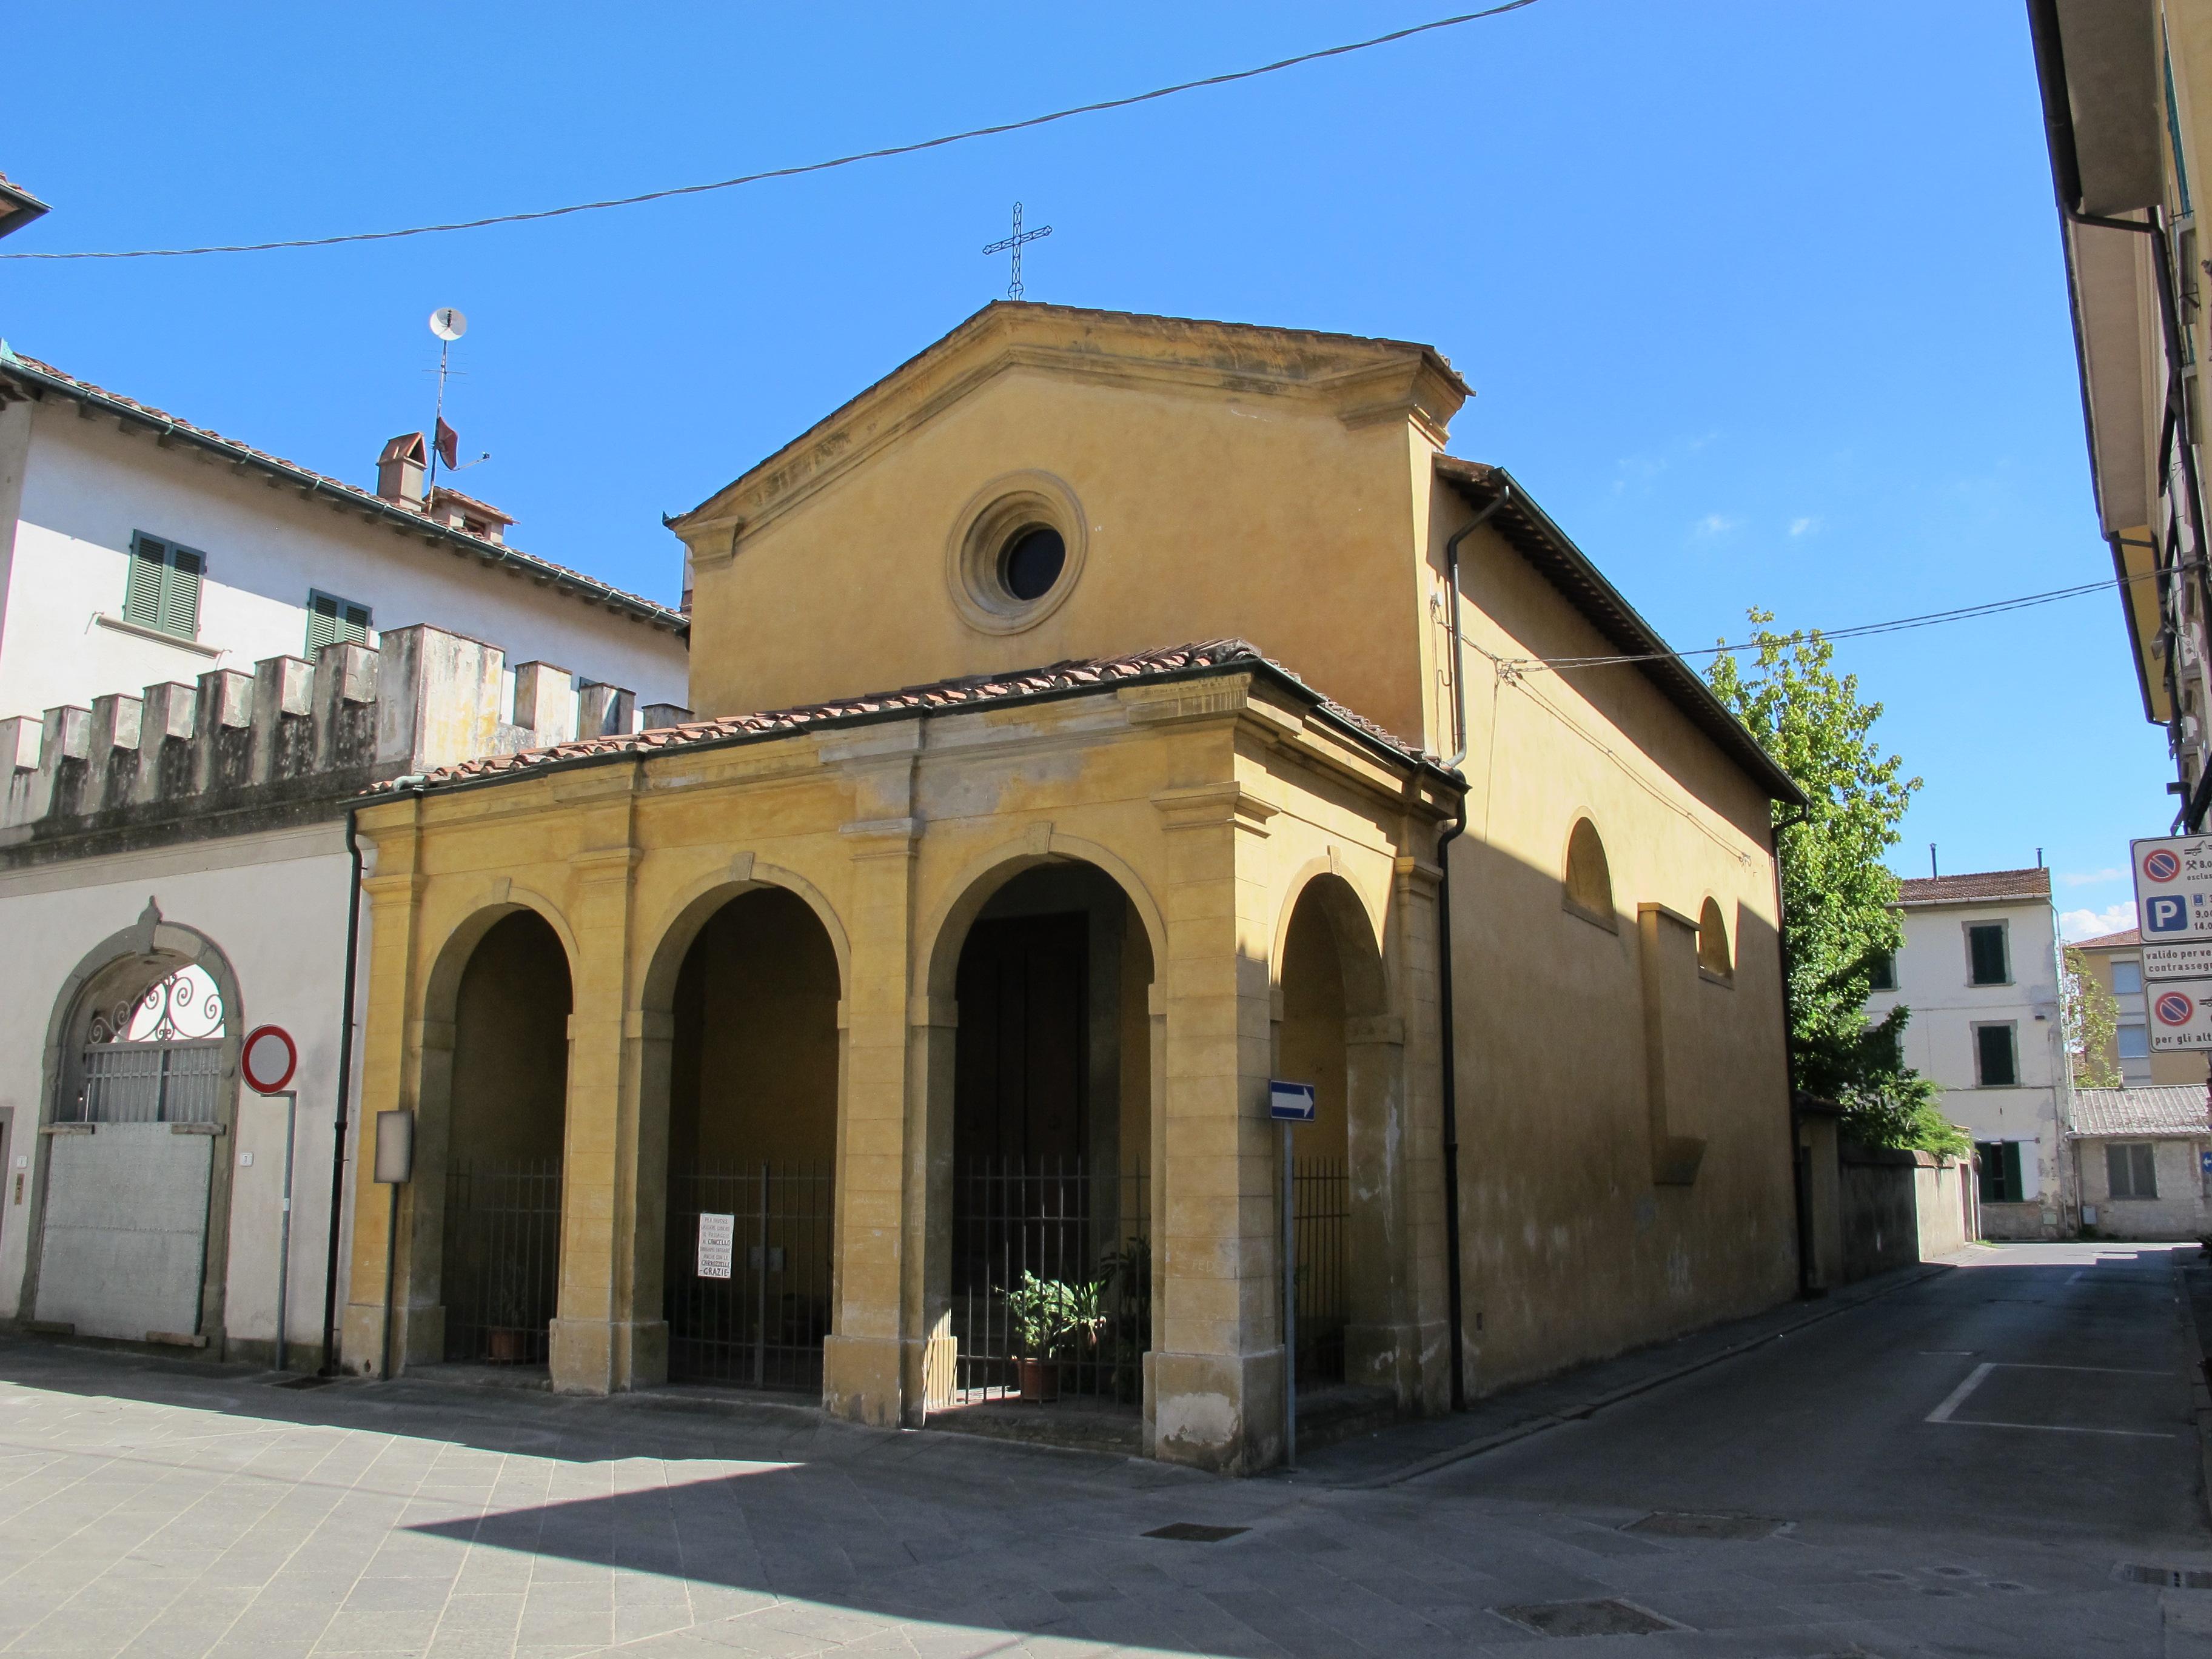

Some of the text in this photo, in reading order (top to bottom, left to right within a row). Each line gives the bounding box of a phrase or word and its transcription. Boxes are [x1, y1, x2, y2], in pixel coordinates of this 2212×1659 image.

[2154, 900, 2177, 928] P
[2146, 950, 2177, 960] valido
[2180, 950, 2197, 960] per
[2155, 1032, 2212, 1045] per gli alt
